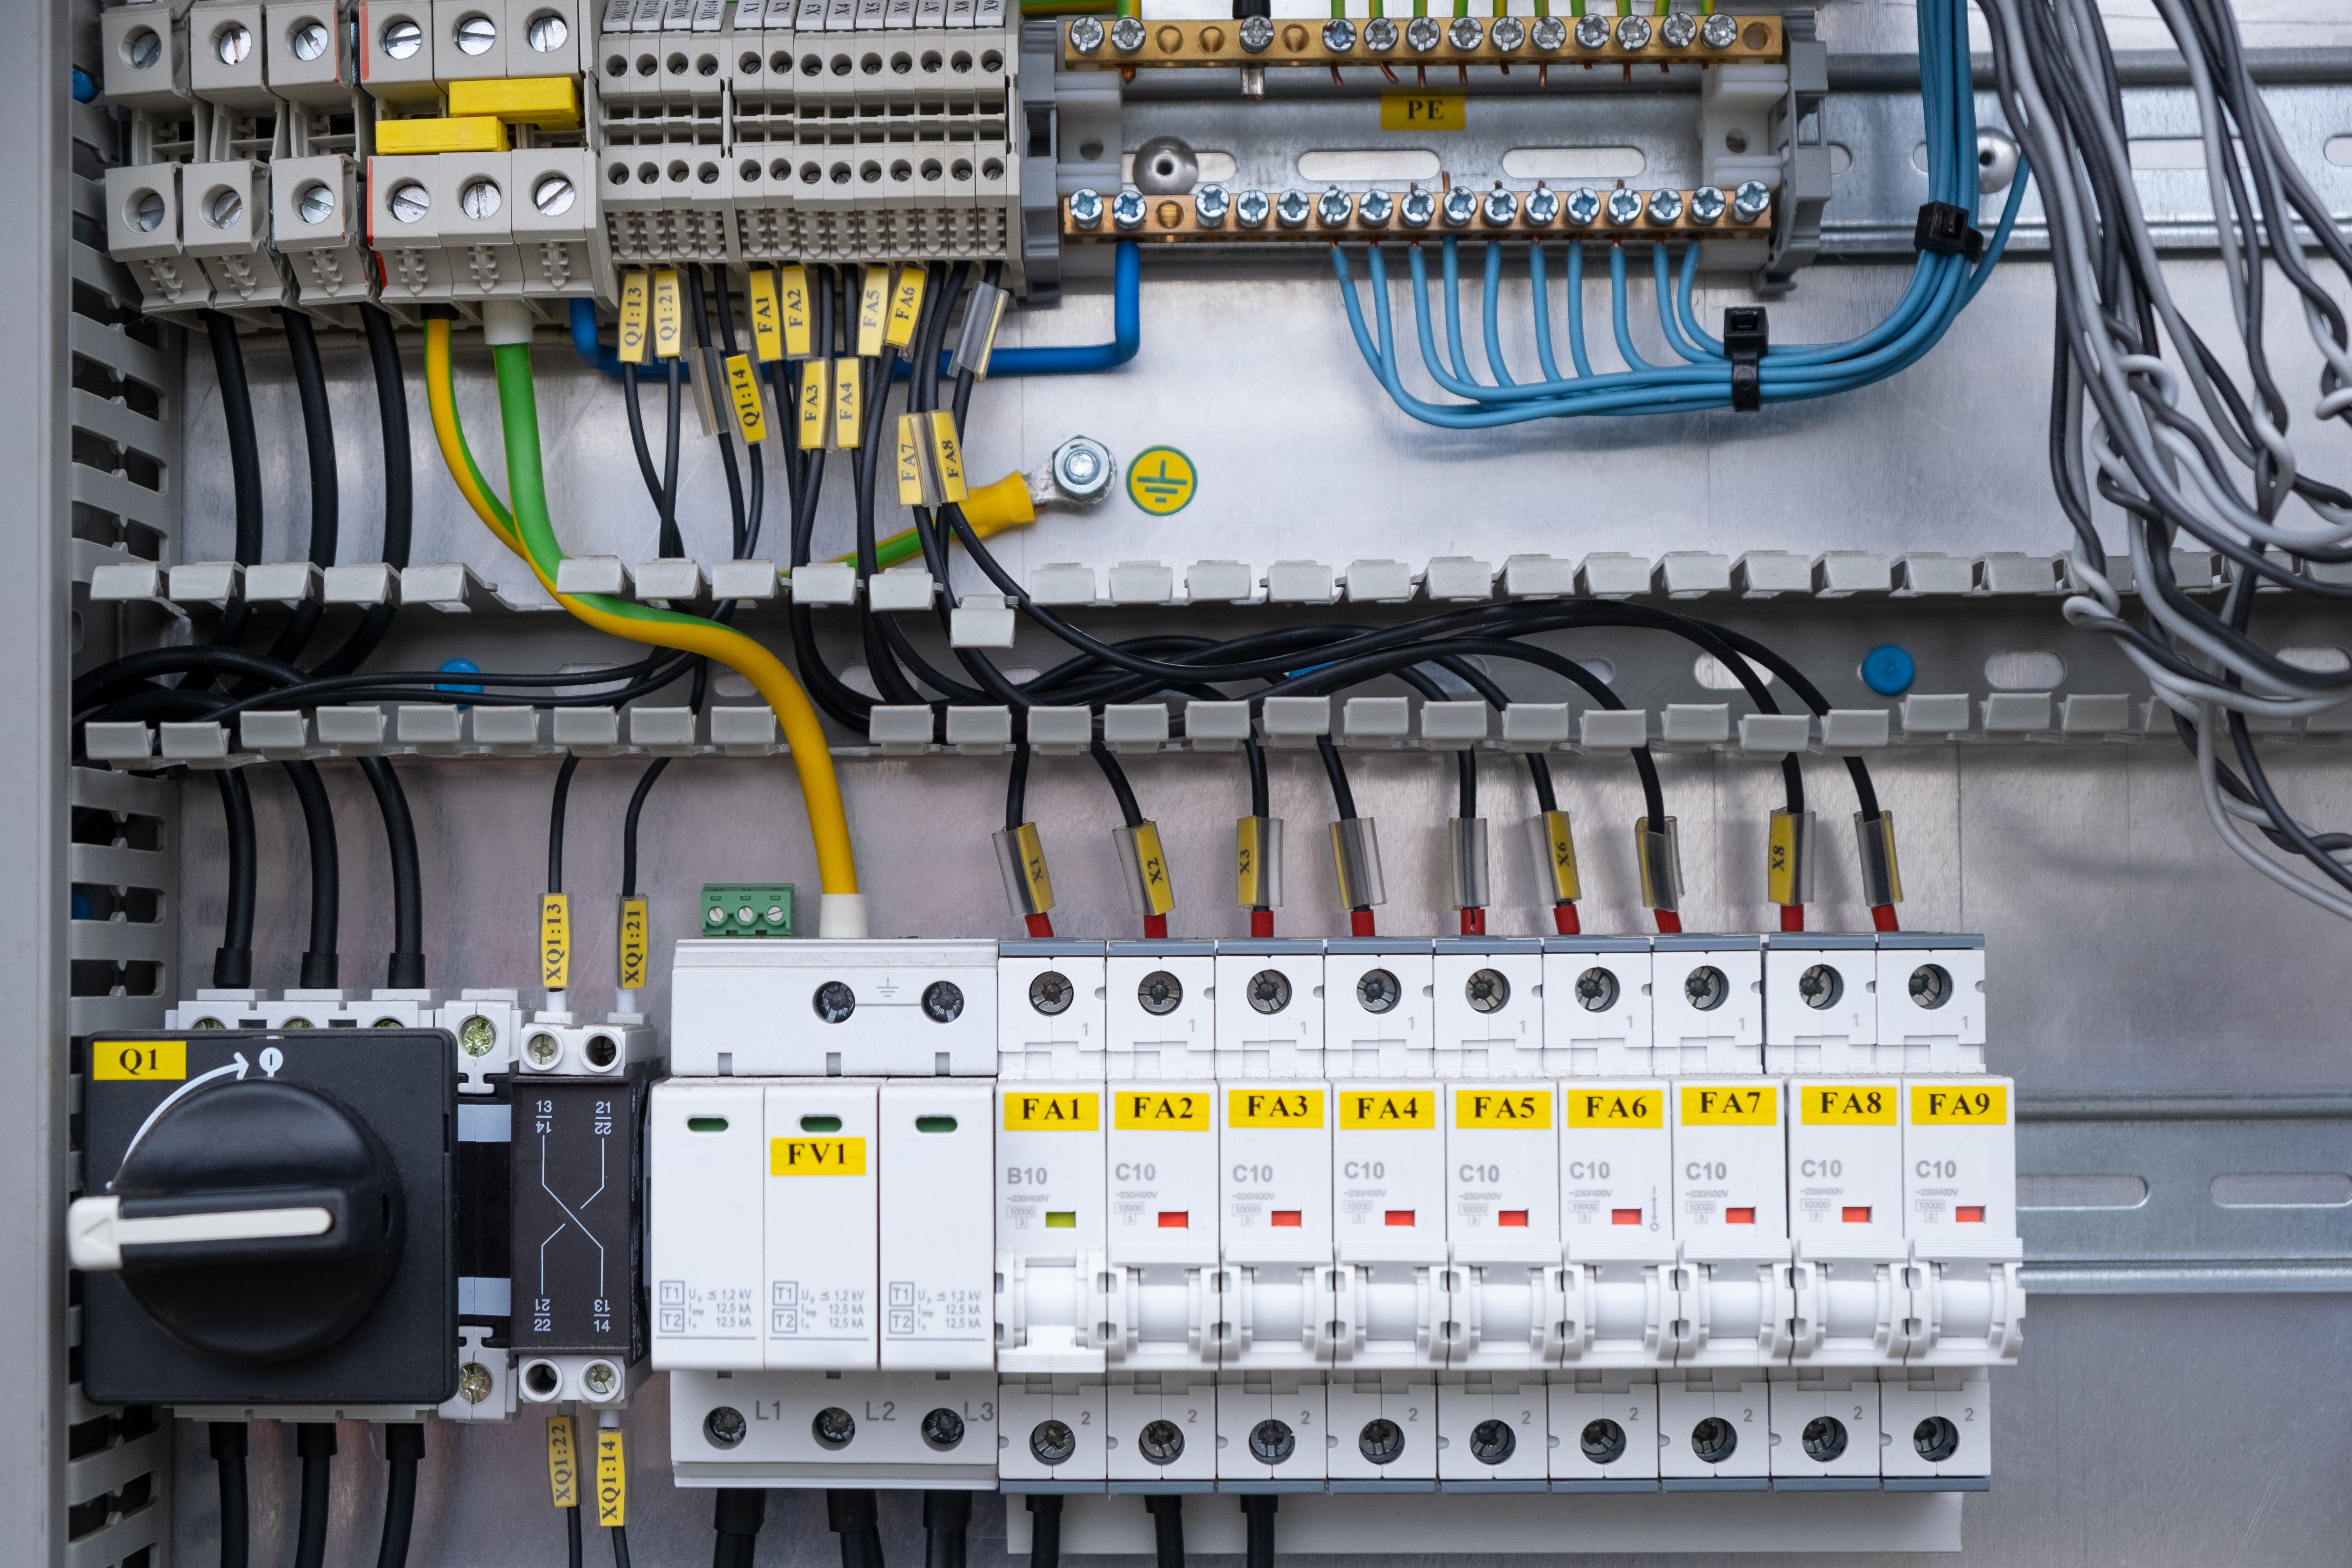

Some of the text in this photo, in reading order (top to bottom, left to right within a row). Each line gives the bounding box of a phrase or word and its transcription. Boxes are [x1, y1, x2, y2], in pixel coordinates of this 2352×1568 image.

[743, 3, 760, 13] X1
[774, 2, 790, 12] X2
[805, 4, 821, 15] X3
[835, 4, 850, 14] X4
[865, 3, 880, 13] X5
[894, 2, 910, 13] X6
[924, 2, 939, 12] X7
[954, 1, 969, 12] X8
[983, 0, 998, 11] X9
[1407, 100, 1444, 120] PE
[624, 287, 643, 346] Q1:13
[659, 283, 677, 341] Q1:21
[731, 368, 760, 427] Q1:14
[1556, 842, 1570, 867] X6
[1773, 845, 1784, 871] X8
[1240, 849, 1249, 875] X3
[1147, 857, 1163, 885] X2
[546, 903, 565, 980] XQ1:13
[625, 910, 643, 983] XQ1:21
[1189, 1019, 1195, 1032] 1
[1408, 1016, 1414, 1030] 1
[1519, 1020, 1525, 1033] 1
[1626, 1015, 1633, 1028] 1
[1739, 1017, 1744, 1030] 1
[1852, 1014, 1858, 1027] 1
[1962, 1016, 1968, 1029] 1
[1082, 1023, 1088, 1035] 1
[1300, 1022, 1306, 1034] 1
[119, 1048, 158, 1075] Q1
[536, 1100, 552, 1112] 13
[596, 1101, 610, 1114] 21
[536, 1122, 552, 1133] 14
[594, 1122, 611, 1134] 22
[788, 1144, 844, 1165] FV1
[1115, 1163, 1155, 1181] C10
[1233, 1165, 1273, 1182] C10
[1344, 1161, 1384, 1179] C10
[1459, 1164, 1499, 1182] C10
[1570, 1162, 1610, 1179] C10
[1686, 1162, 1727, 1180] C10
[1801, 1159, 1842, 1177] C10
[1916, 1161, 1956, 1178] C10
[1007, 1167, 1047, 1185] B10
[1010, 1207, 1033, 1216] 10000
[1236, 1204, 1260, 1213] 10000
[1573, 1203, 1597, 1211] 10000
[1690, 1203, 1714, 1211] 10000
[663, 1287, 678, 1299] T1
[722, 1289, 735, 1301] 1,2
[739, 1290, 751, 1300] kV
[776, 1287, 791, 1300] T1
[835, 1290, 848, 1302] 1,2
[852, 1291, 864, 1301] kV
[893, 1288, 908, 1301] T1
[951, 1291, 965, 1302] 1,2
[968, 1291, 981, 1301] kV
[536, 1299, 550, 1311] 21
[594, 1300, 610, 1312] 13
[716, 1302, 736, 1314] 12,5
[739, 1303, 751, 1313] kA
[829, 1303, 848, 1316] 12,5
[852, 1304, 864, 1314] kA
[946, 1304, 965, 1316] 12,5
[969, 1304, 980, 1315] kA
[534, 1319, 551, 1331] 22
[594, 1319, 610, 1332] 14
[663, 1314, 681, 1327] T2
[716, 1316, 735, 1328] 12,5
[739, 1317, 751, 1327] kA
[776, 1315, 794, 1327] T2
[829, 1317, 848, 1329] 12,5
[852, 1318, 864, 1328] kA
[892, 1315, 910, 1328] T2
[946, 1318, 965, 1329] 12,5
[968, 1318, 980, 1328] kA
[755, 1399, 783, 1420] L1
[865, 1400, 895, 1421] L2
[963, 1401, 994, 1421] L3
[1188, 1409, 1197, 1423] 2
[1409, 1407, 1417, 1421] 2
[1629, 1406, 1638, 1421] 2
[1744, 1408, 1753, 1422] 2
[1854, 1406, 1862, 1419] 2
[1965, 1408, 1974, 1421] 2
[1081, 1410, 1090, 1425] 2
[1301, 1410, 1310, 1424] 2
[1522, 1410, 1531, 1424] 2
[552, 1424, 573, 1501] XQ1:22
[601, 1441, 620, 1520] XQ1:14
